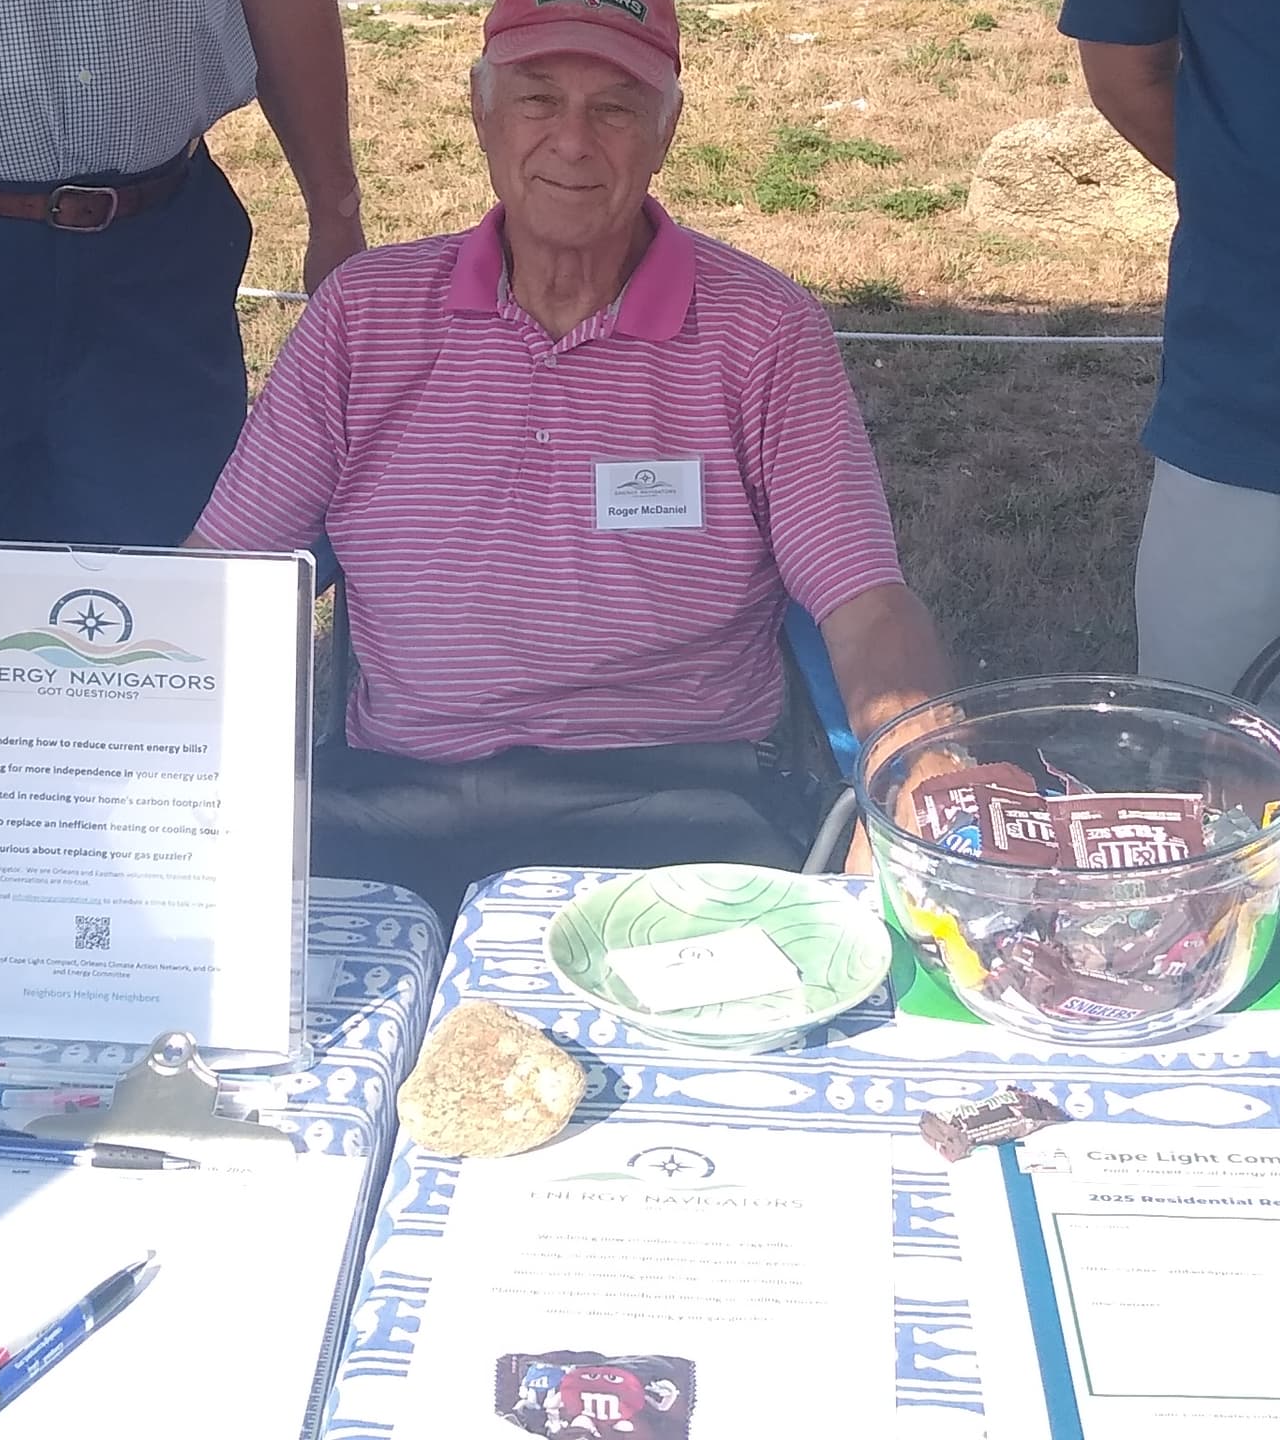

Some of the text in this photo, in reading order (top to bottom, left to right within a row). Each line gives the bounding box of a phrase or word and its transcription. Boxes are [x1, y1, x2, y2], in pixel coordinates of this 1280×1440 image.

[608, 505, 687, 517] Roger McDaniel
[69, 670, 216, 690] NAVIGATORS
[37, 687, 139, 700] GOT QUESTIONS?
[36, 738, 57, 747] how
[60, 739, 71, 747] to
[72, 740, 106, 749] reduce
[108, 742, 144, 751] current
[146, 744, 180, 754] energy
[182, 744, 208, 753] bills?
[8, 763, 22, 773] for
[25, 766, 51, 774] more
[53, 766, 122, 779] independence
[124, 769, 133, 778] in
[135, 770, 158, 780] your
[160, 772, 194, 782] energy
[196, 772, 219, 781] use?
[17, 791, 27, 800] in
[29, 792, 71, 803] reducing
[73, 794, 96, 804] your
[98, 795, 133, 805] home's
[135, 797, 170, 807] carbon
[172, 799, 221, 809] footprint?
[6, 817, 42, 830] replace
[44, 820, 56, 828] an
[58, 819, 107, 831] inefficient
[110, 823, 147, 834] heating
[149, 825, 159, 833] or
[162, 824, 197, 836] cooling
[32, 845, 62, 855] about
[63, 847, 108, 859] replacing
[110, 850, 132, 859] your
[134, 852, 151, 861] gas
[153, 852, 192, 862] guzzler?
[23, 987, 160, 1003] Neighbors Helping Neighbors
[1064, 997, 1137, 1021] SNICKERS
[1086, 1150, 1148, 1163] Cape
[1156, 1151, 1220, 1165] Light
[530, 1191, 804, 1209] ENERGY NAVIGATORS
[1088, 1193, 1135, 1203] 2025
[1141, 1194, 1253, 1206] Residential
[580, 1391, 621, 1420] m
